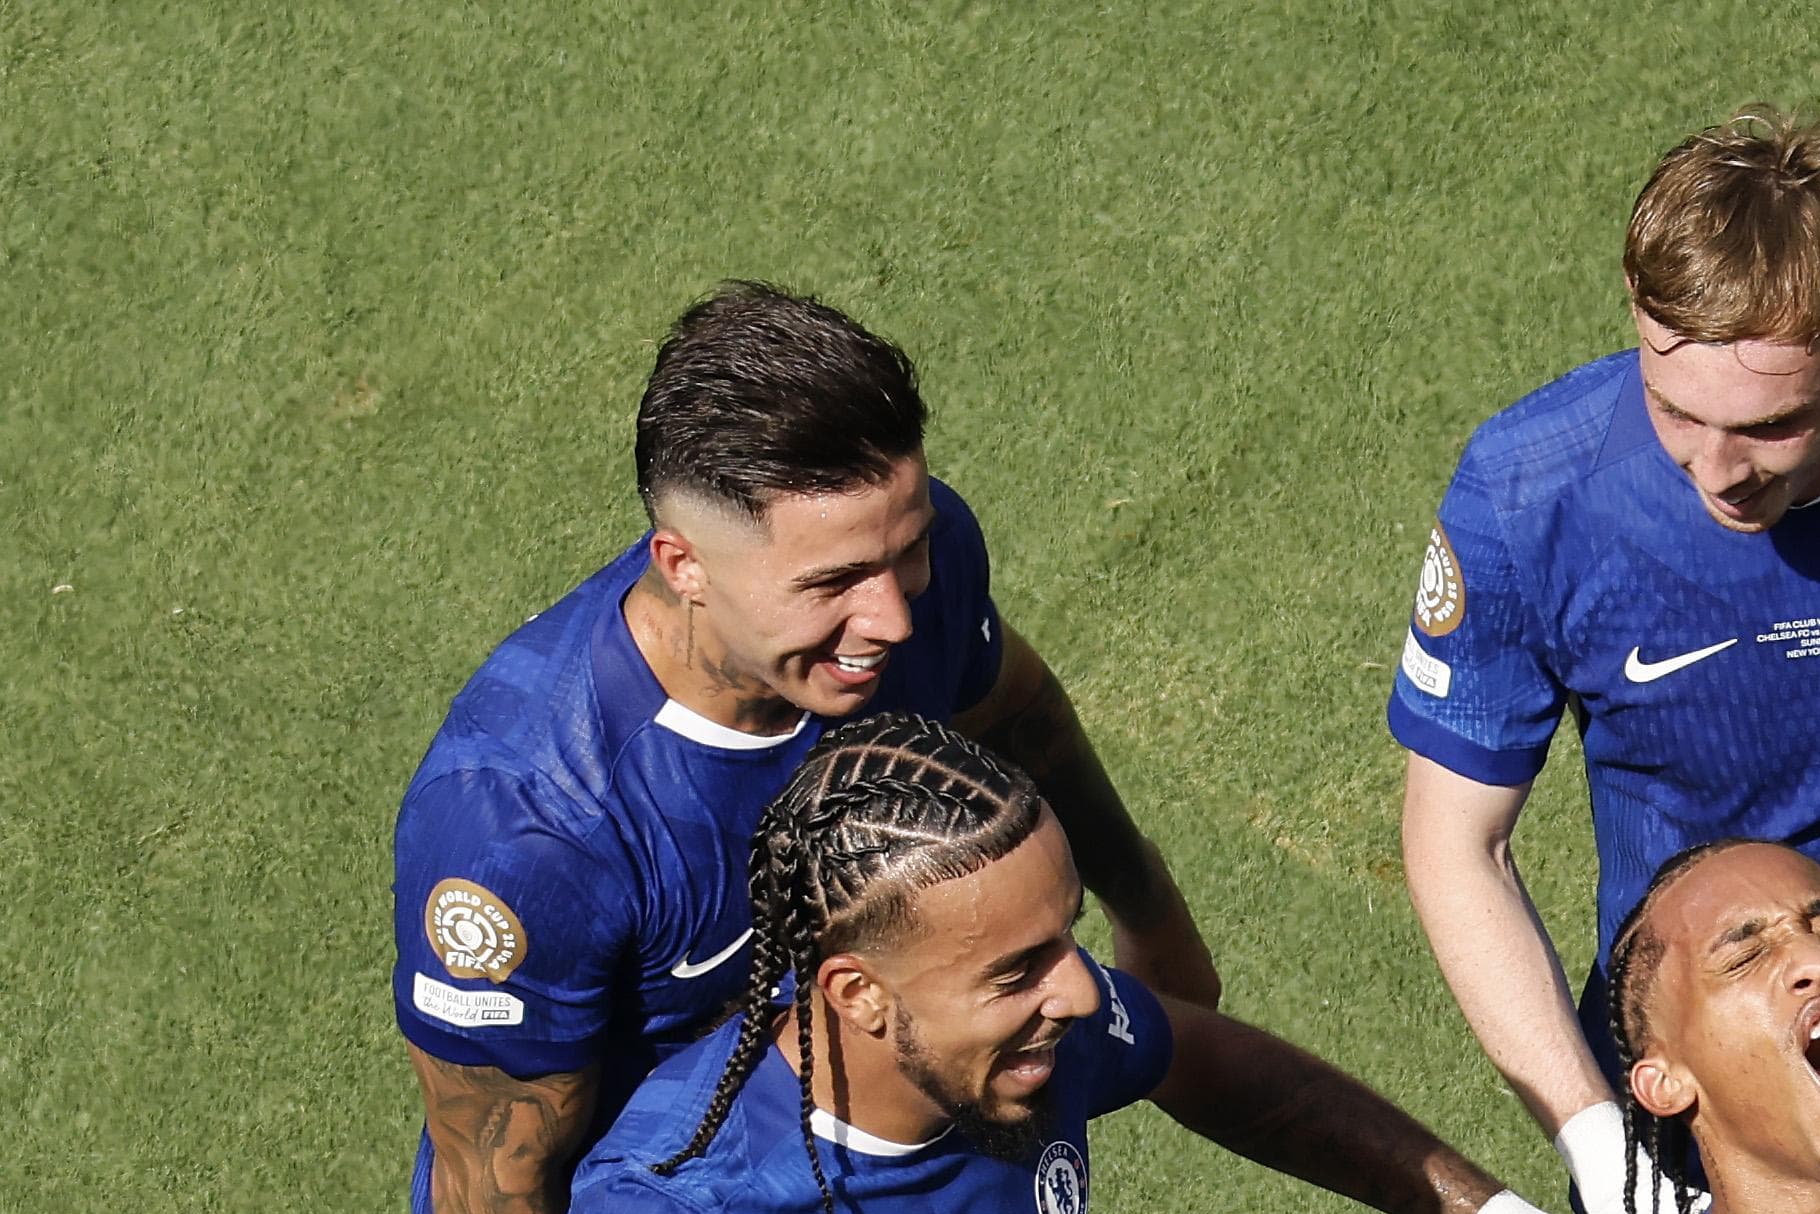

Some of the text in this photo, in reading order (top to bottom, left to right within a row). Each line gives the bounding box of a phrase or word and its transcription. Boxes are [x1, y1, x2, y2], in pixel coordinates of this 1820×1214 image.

[1774, 622, 1792, 631] FIFA
[1792, 618, 1816, 629] CLUB
[1756, 632, 1798, 642] CHELSEA
[1798, 630, 1810, 638] FC
[1786, 648, 1808, 658] NEW
[438, 890, 516, 970] WORLD CUP 25 USA
[424, 983, 511, 1007] FOOTBALL UNITES
